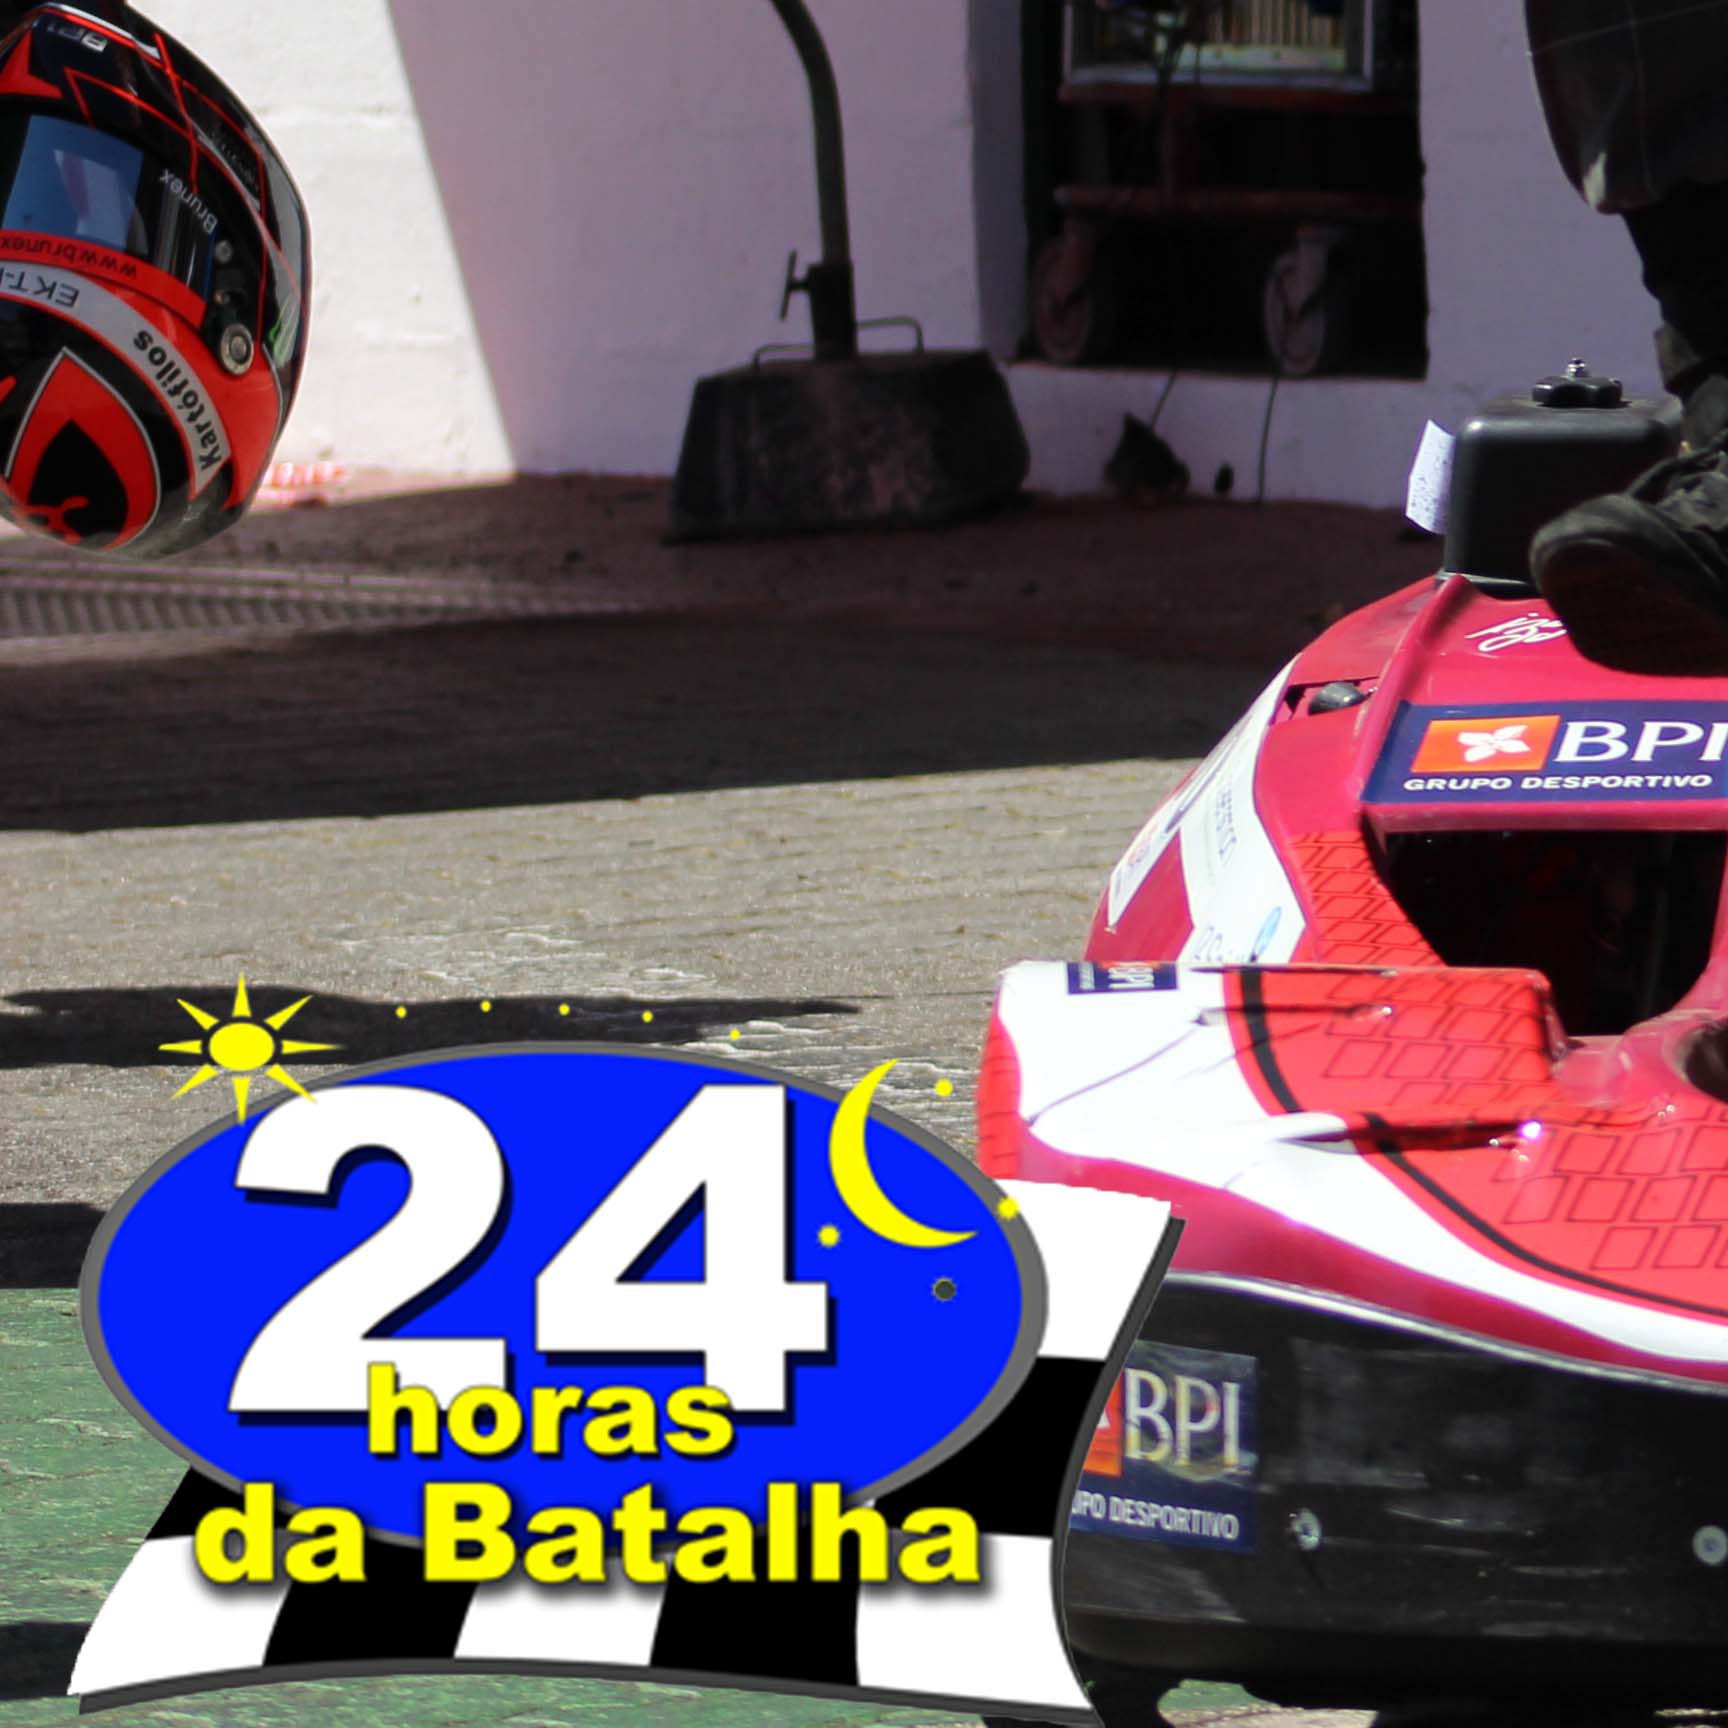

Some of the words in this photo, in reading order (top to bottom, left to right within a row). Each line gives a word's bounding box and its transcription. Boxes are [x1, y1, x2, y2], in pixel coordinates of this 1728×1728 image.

[158, 168, 218, 235] Brunex
[133, 329, 223, 472] Kartófilos
[1403, 777, 1512, 792] GRUPO
[1520, 774, 1714, 790] DESPORTIVO
[1124, 1368, 1241, 1467] BPI
[1108, 1495, 1240, 1541] DESPORTIVO
